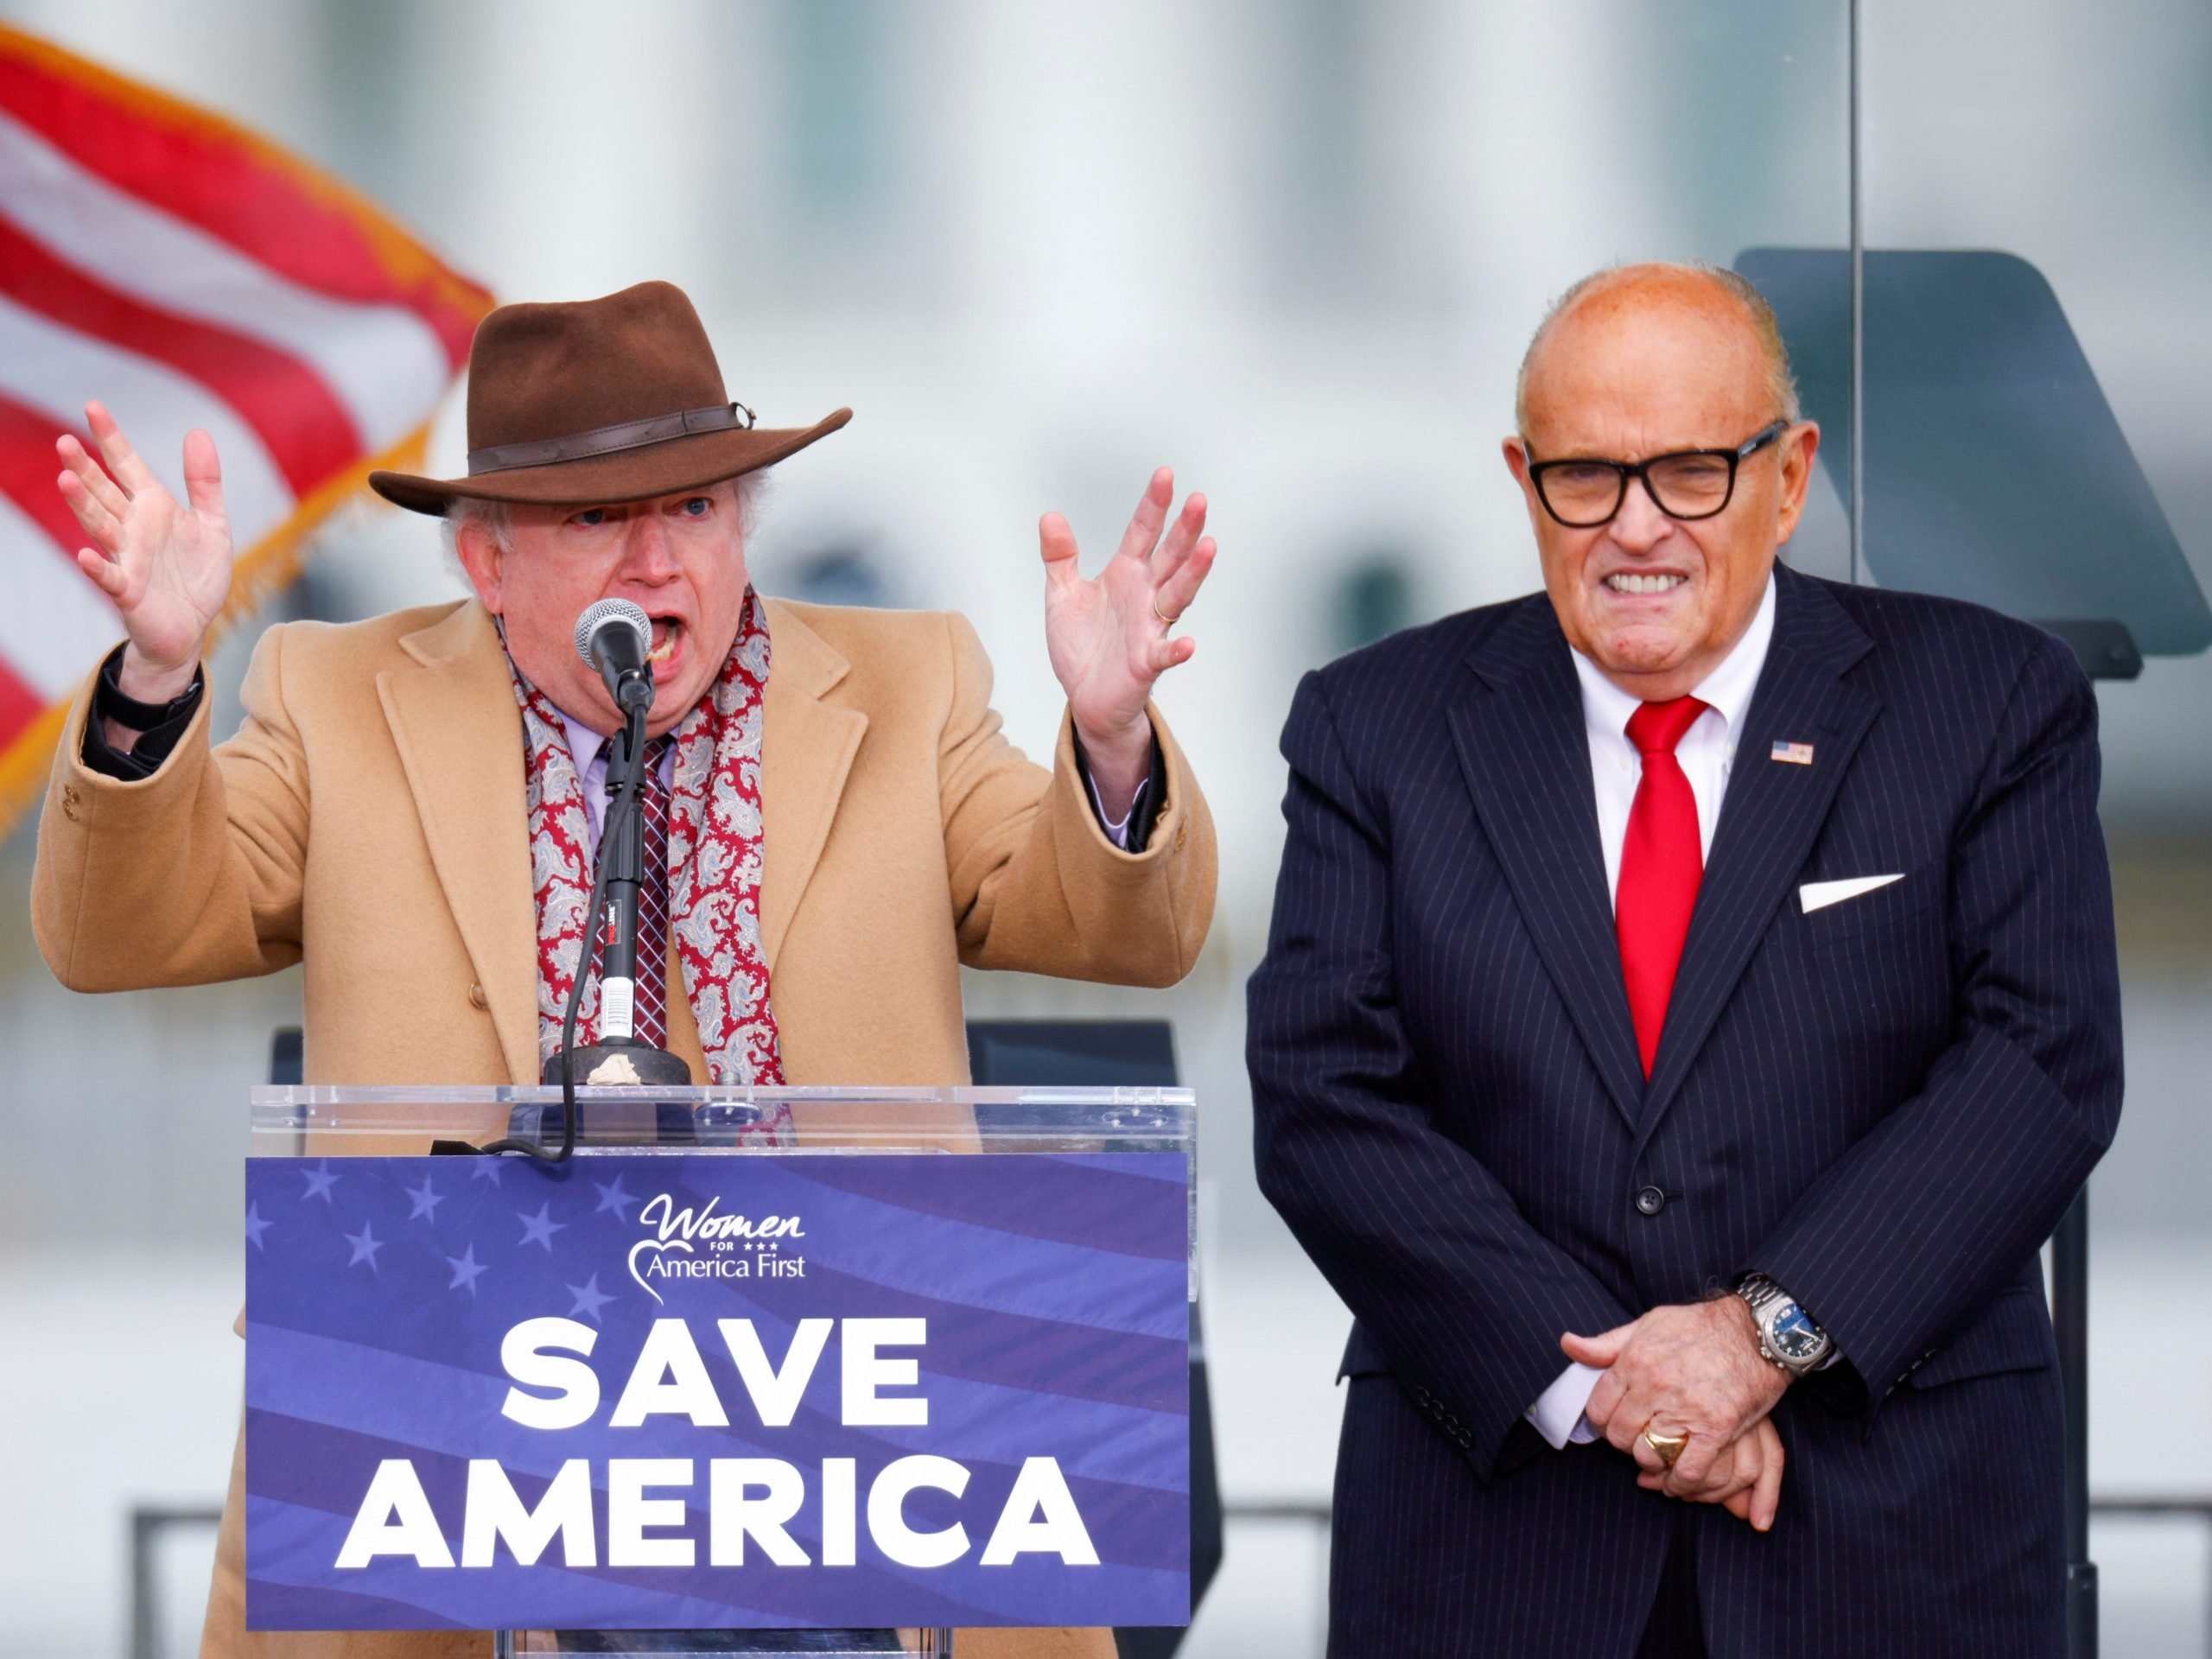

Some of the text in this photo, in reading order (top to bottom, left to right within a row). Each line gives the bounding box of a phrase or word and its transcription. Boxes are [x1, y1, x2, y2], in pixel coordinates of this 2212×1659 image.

[639, 1193, 805, 1242] Women
[646, 1253, 806, 1278] America First
[709, 1241, 734, 1252] FOR
[500, 1316, 929, 1431] SAVE
[334, 1453, 1102, 1569] AMERICA
